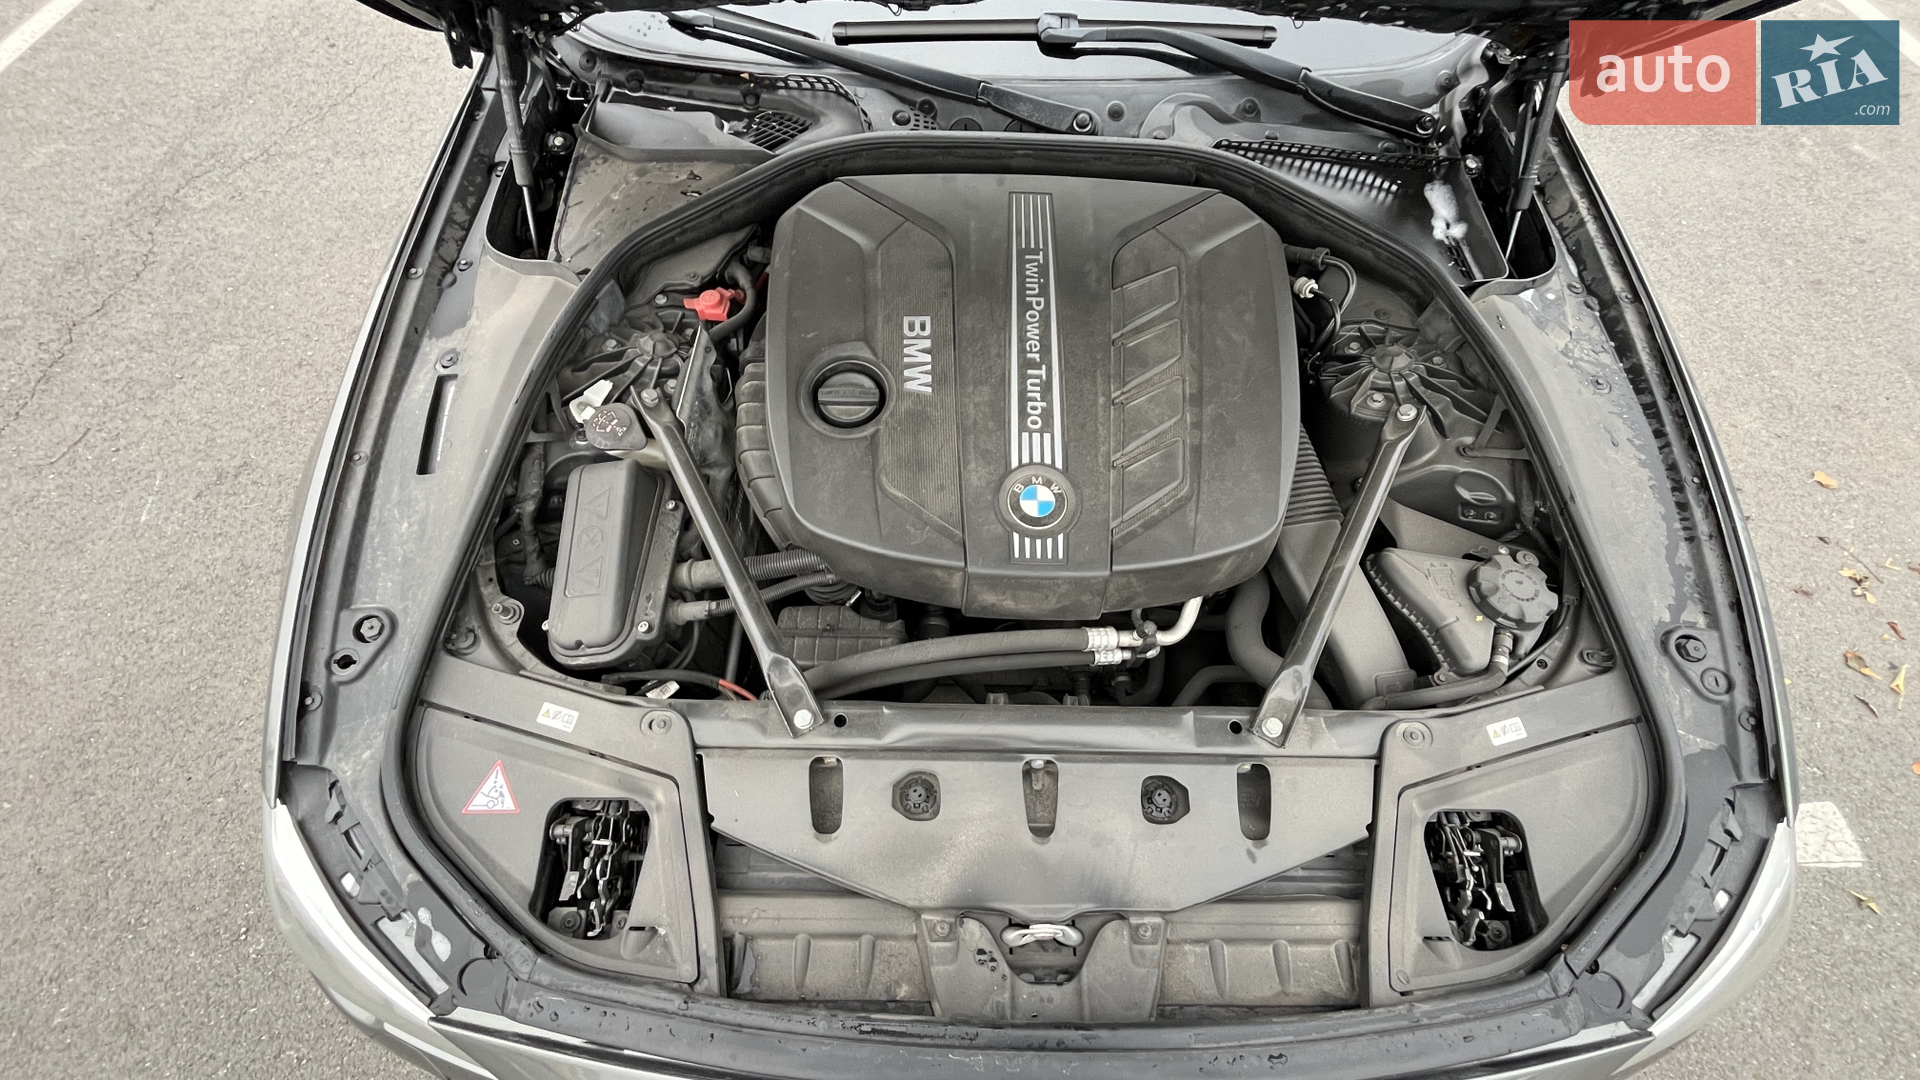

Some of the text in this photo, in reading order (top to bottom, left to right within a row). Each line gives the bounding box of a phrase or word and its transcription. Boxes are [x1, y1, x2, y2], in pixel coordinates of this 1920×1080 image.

[903, 315, 932, 393] BMW
[1025, 251, 1047, 429] TwinPower Turbo
[1013, 476, 1062, 494] BMW
